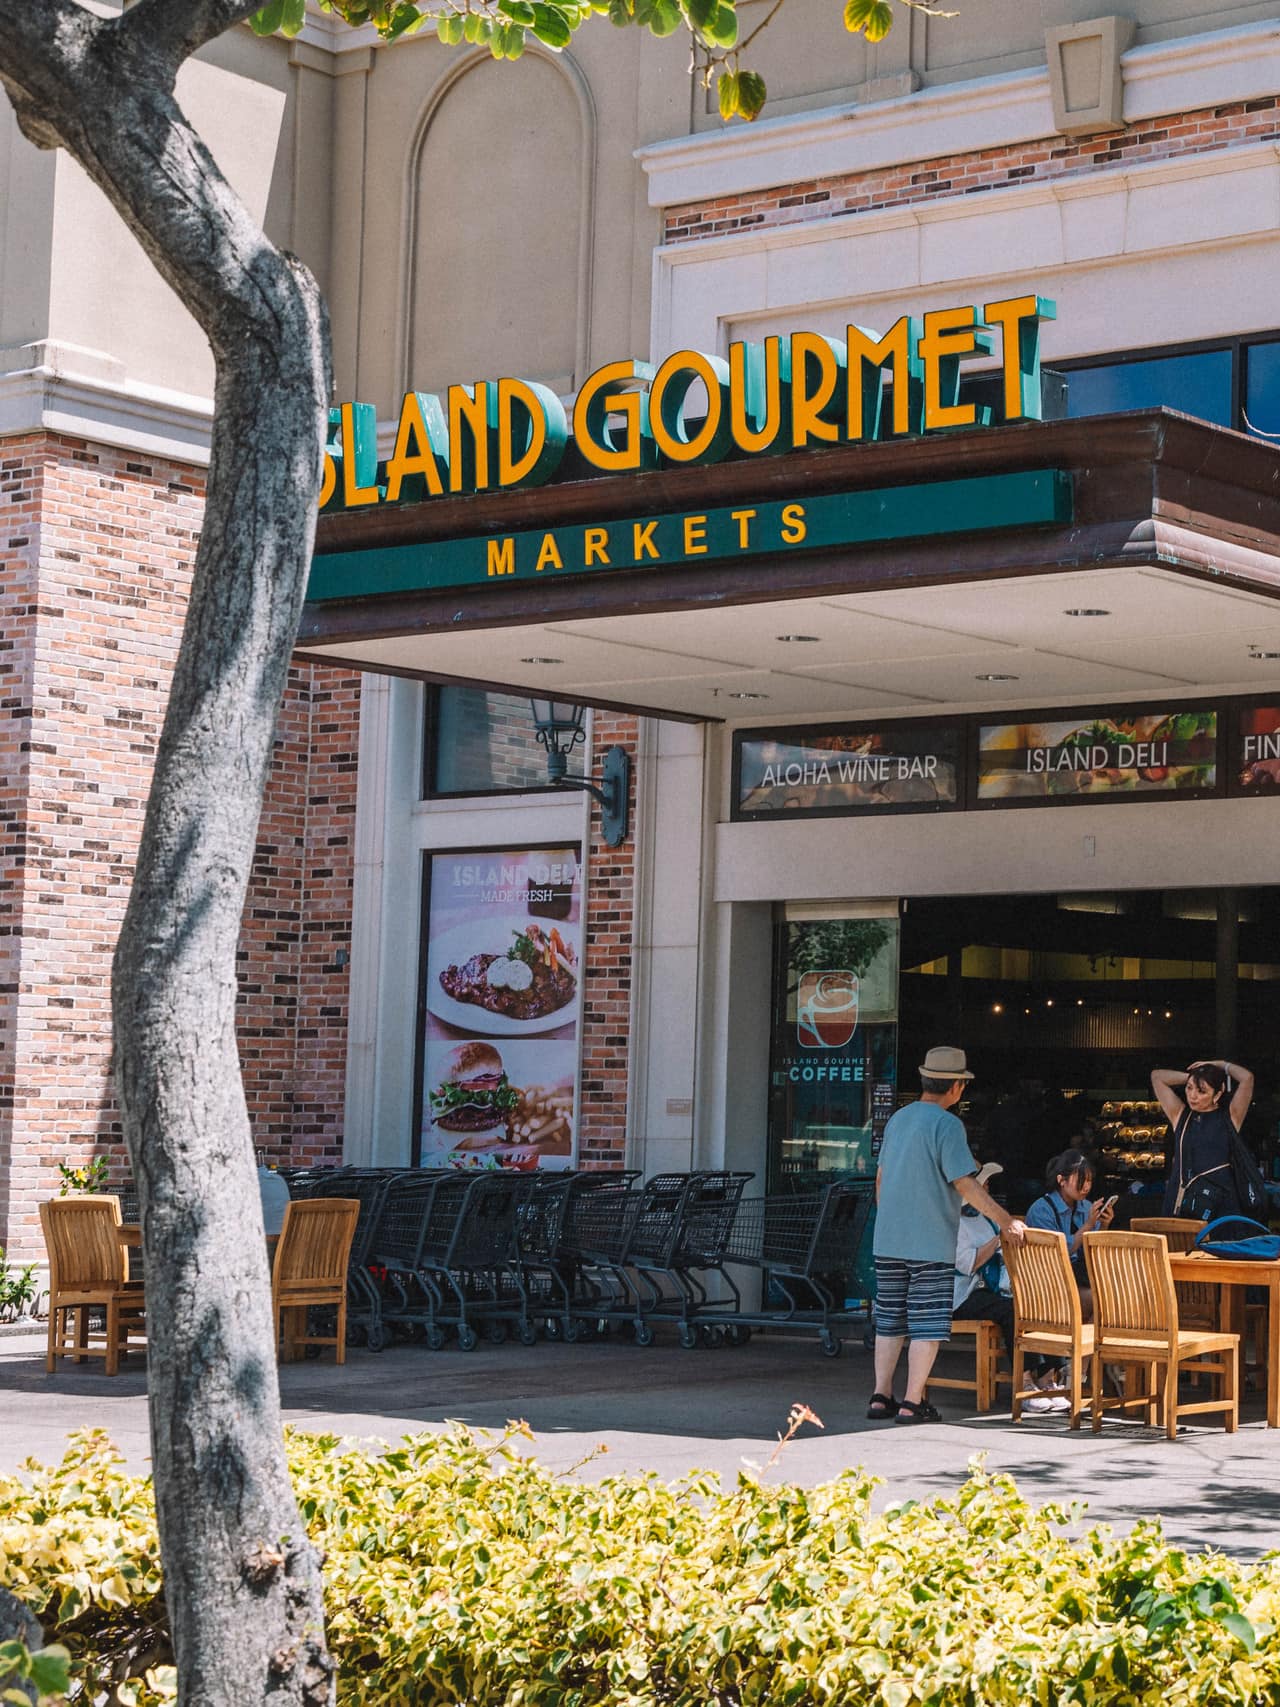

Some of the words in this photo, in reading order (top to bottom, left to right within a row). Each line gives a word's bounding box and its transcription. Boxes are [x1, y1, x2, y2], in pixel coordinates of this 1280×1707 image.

[573, 295, 1037, 470] GOURMET
[487, 504, 807, 577] MARKETS
[761, 763, 831, 788] ALOHA
[837, 758, 890, 784] WINE
[897, 755, 938, 780] BAR
[1026, 744, 1108, 773] ISLAND
[1117, 742, 1168, 768] DELI
[480, 890, 514, 903] MADE
[516, 889, 553, 902] FRESH
[783, 1057, 818, 1065] ISLAND
[824, 1057, 871, 1065] GOURMET
[789, 1066, 865, 1081] COFFEE
